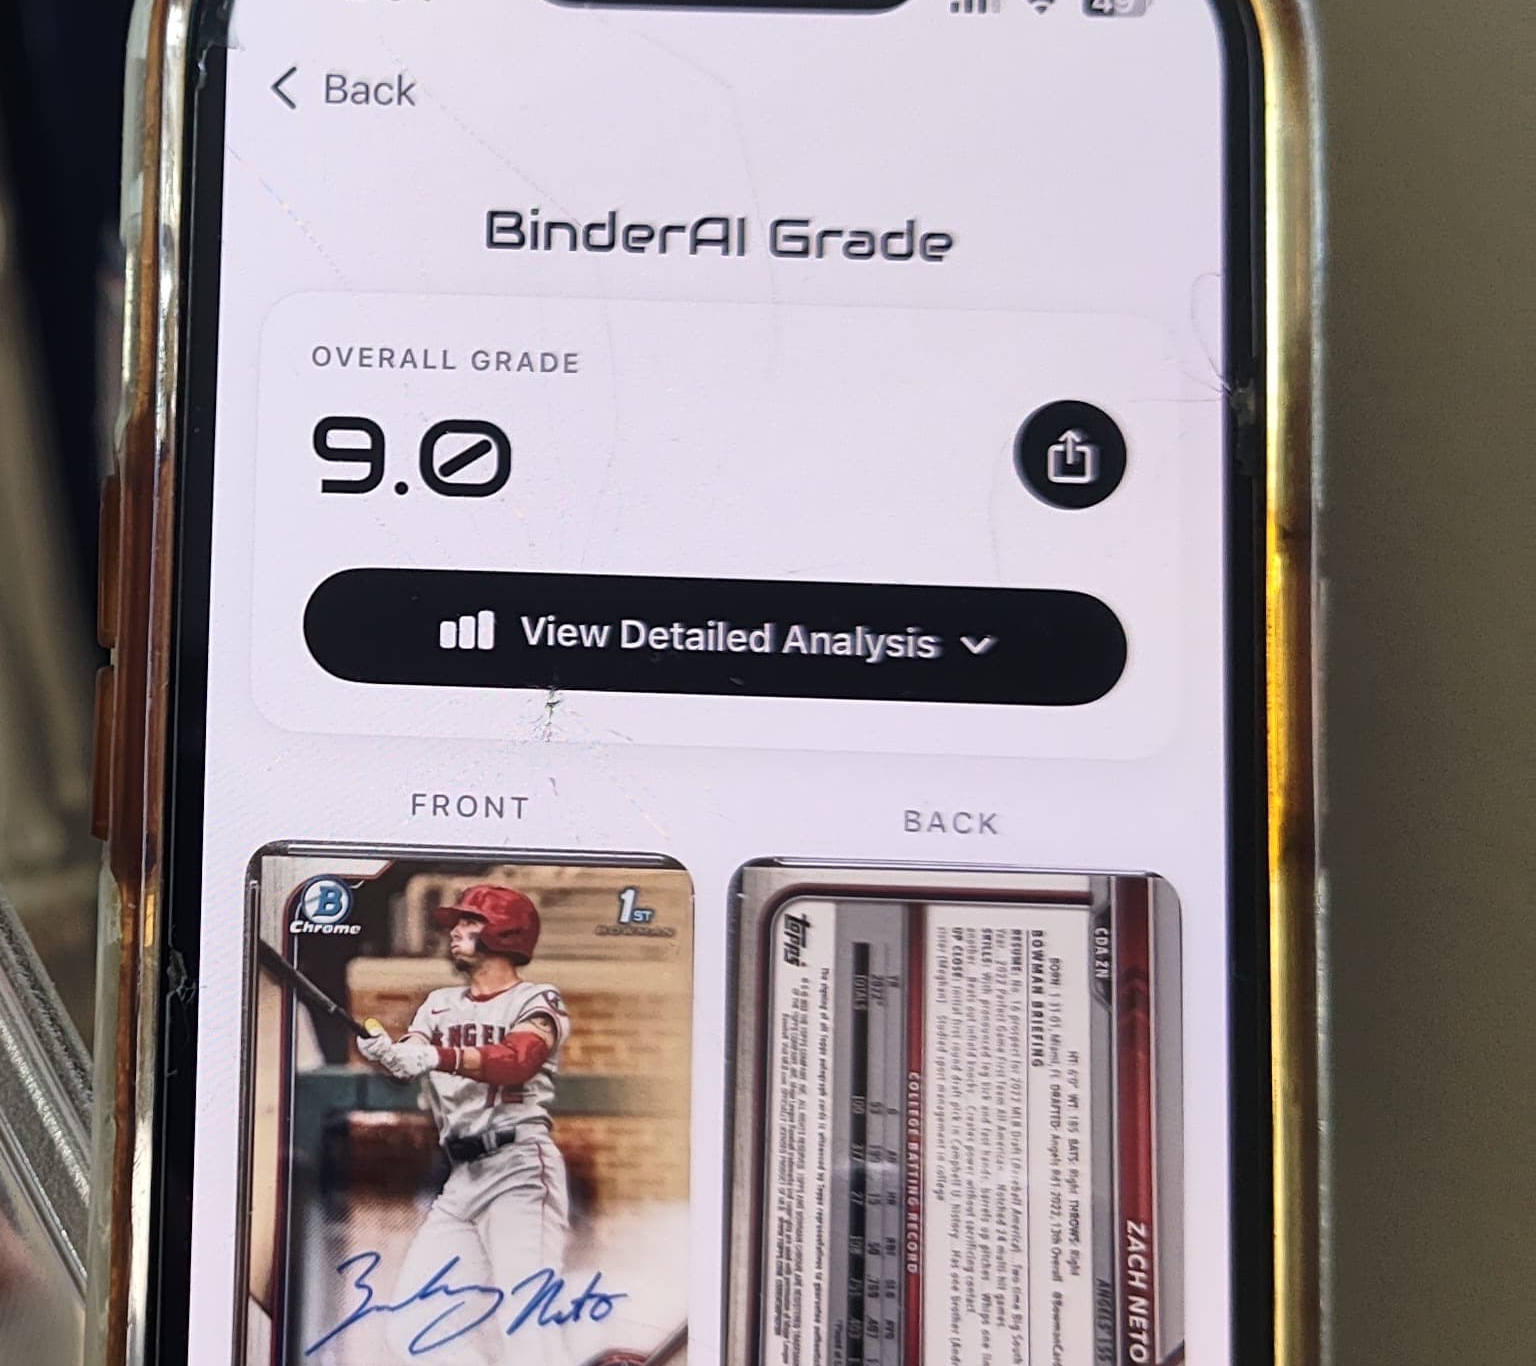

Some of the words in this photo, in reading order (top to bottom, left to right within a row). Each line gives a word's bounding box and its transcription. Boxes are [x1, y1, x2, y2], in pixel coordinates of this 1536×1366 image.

[324, 72, 417, 107] Back
[485, 207, 747, 258] BinderAI
[769, 217, 955, 263] Grade
[310, 344, 458, 371] OVERALL
[470, 348, 580, 375] GRADE
[311, 414, 513, 499] 9.0
[519, 613, 612, 649] View
[619, 618, 773, 654] Detailed
[781, 623, 940, 664] Analysis
[410, 792, 530, 821] FRONT
[903, 808, 999, 836] BACK
[289, 920, 362, 936] Chrome
[1031, 929, 1045, 995] BOWMAN
[1031, 1001, 1045, 1068] BRIEFING
[907, 1072, 920, 1136] COLLEGE
[906, 1142, 920, 1207] BATTING
[906, 1212, 919, 1274] RECORD
[1125, 1220, 1149, 1290] ZACH
[1012, 1334, 1024, 1365] South
[1128, 1295, 1151, 1364] NETO
